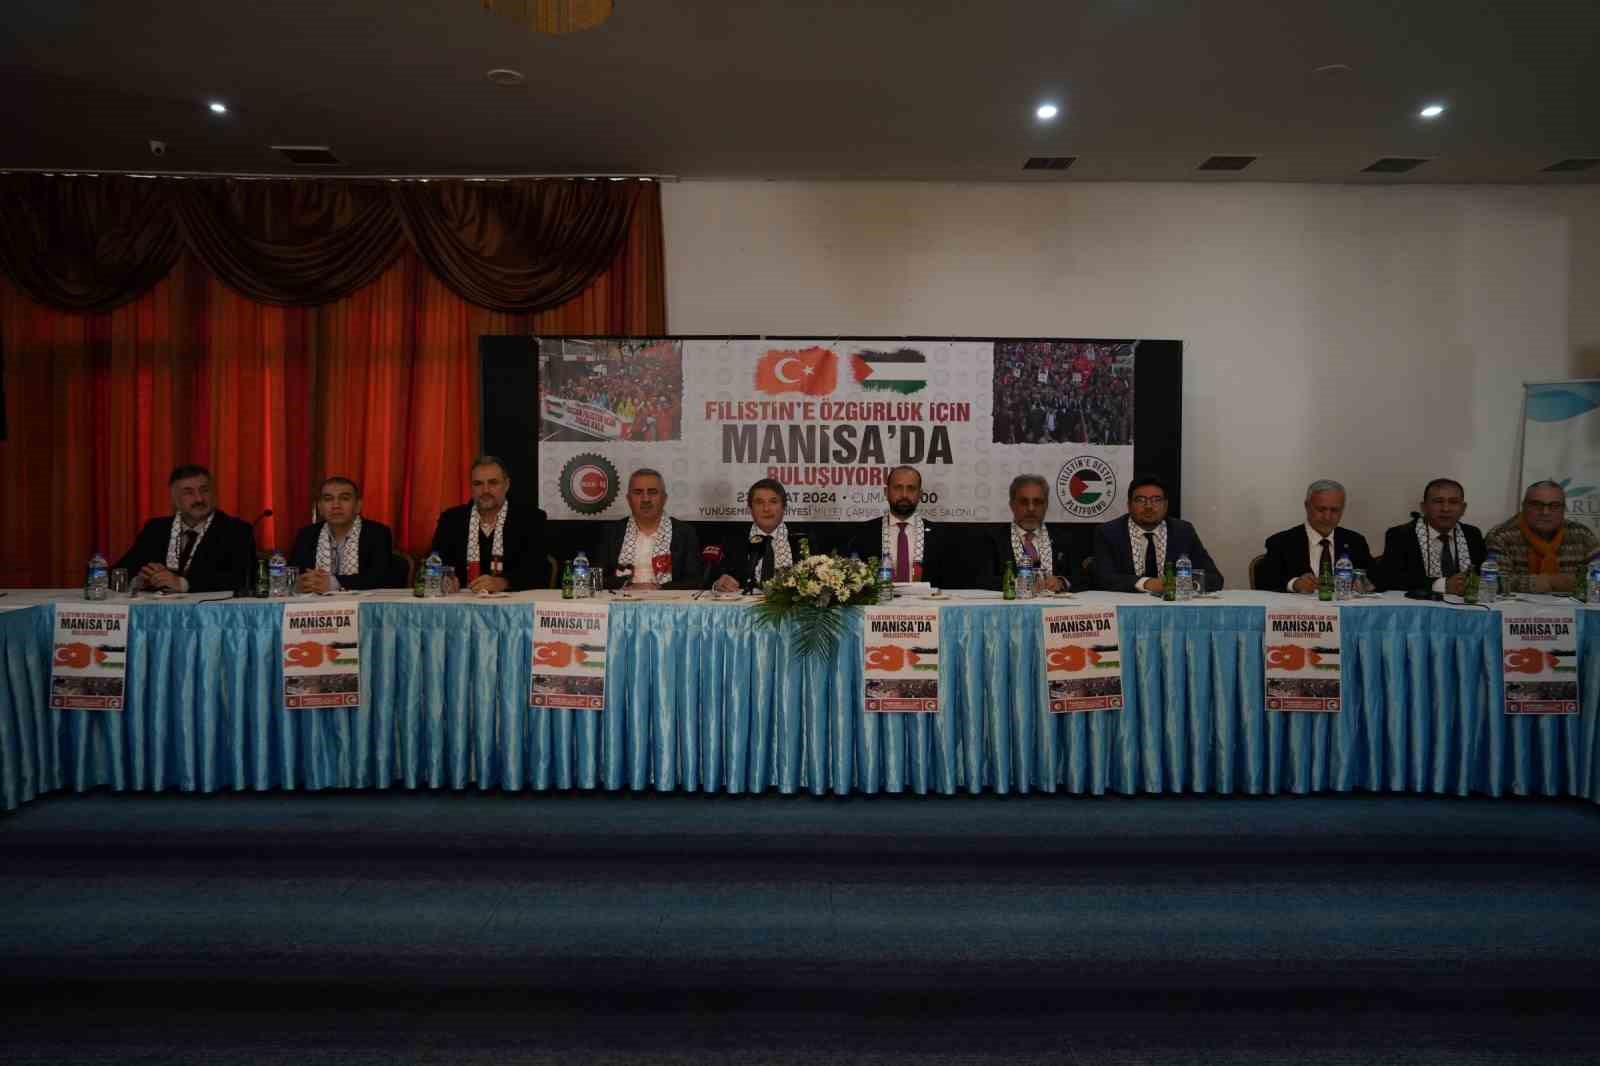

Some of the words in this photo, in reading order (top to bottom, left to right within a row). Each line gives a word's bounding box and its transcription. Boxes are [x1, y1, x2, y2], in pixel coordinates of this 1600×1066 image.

[705, 402, 815, 421] FİLİSTİN'E
[819, 398, 923, 421] ÖZGÜRLÜK
[929, 402, 970, 423] İÇİN
[722, 424, 953, 464] MANİSA'DA
[767, 466, 892, 487] BULUŞUYORU
[802, 492, 836, 503] 2024
[698, 507, 751, 516] YUNUSEM
